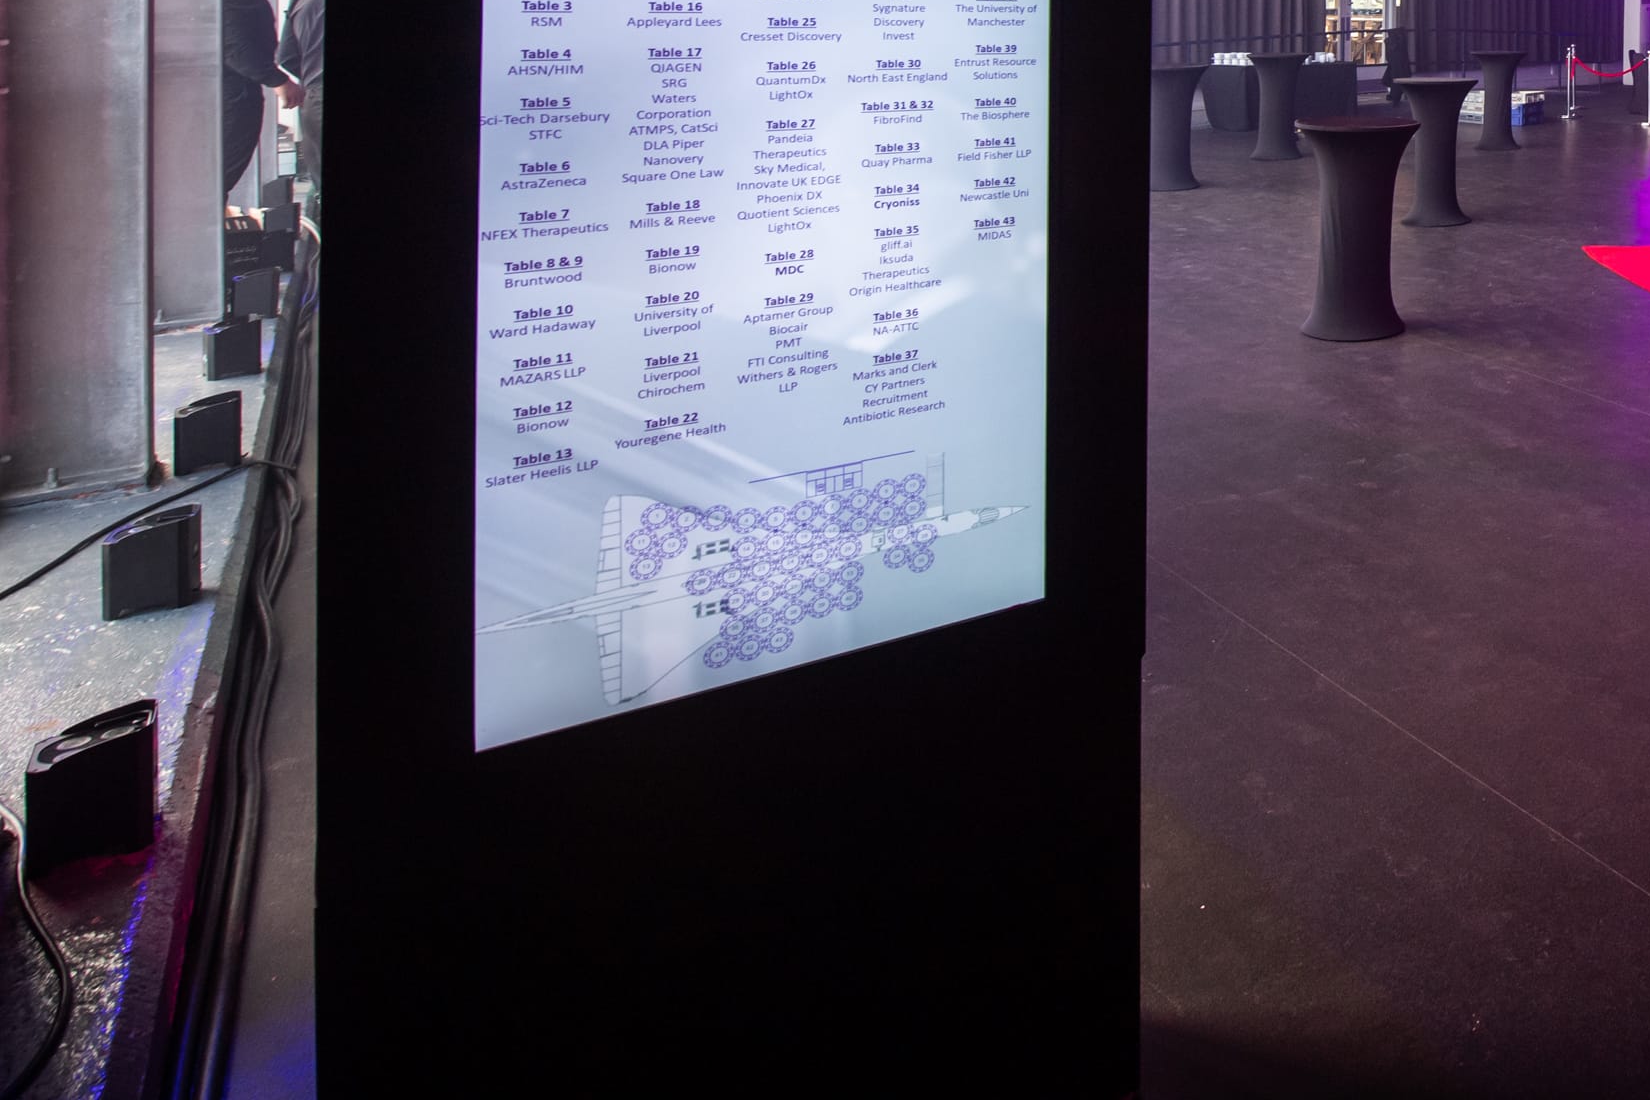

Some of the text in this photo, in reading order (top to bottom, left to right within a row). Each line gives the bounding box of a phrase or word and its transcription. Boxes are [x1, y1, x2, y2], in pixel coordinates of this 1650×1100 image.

[872, 3, 926, 15] Sygnature
[530, 16, 563, 27] RSM
[626, 16, 722, 29] Appleyard Lees
[873, 17, 925, 29] Discovery
[967, 17, 1026, 27] Manchester
[740, 31, 842, 43] Cresset Discovery
[882, 31, 915, 41] Invest
[650, 62, 702, 74] QIAGEN
[954, 57, 1037, 68] Entrust Resource
[507, 64, 584, 77] AHSN/HIM
[847, 71, 948, 84] North East England
[972, 70, 1019, 81] Solutions
[661, 78, 688, 89] SRG
[755, 75, 826, 86] QuantumDx
[519, 96, 571, 108] Table 5
[651, 94, 697, 104] Waters
[769, 90, 814, 102] LightOx
[974, 97, 1017, 107] Table 40
[540, 111, 610, 124] Darsebury
[636, 108, 712, 122] Corporation
[873, 113, 923, 125] FibroFind
[959, 110, 1030, 122] The Biosphere
[528, 128, 563, 141] STFC
[628, 122, 719, 136] ATMPS, CatSci
[643, 139, 705, 151] DLA Piper
[643, 155, 705, 167] Nanovery
[752, 148, 827, 161] Therapeutics
[957, 148, 1032, 162] Field Fisher LLP
[861, 156, 933, 169] Quay Pharma
[621, 168, 725, 185] Square One Law
[753, 164, 775, 176] Sky
[500, 177, 587, 191] AstraZeneca
[736, 174, 841, 191] Innovate UK EDGE
[874, 183, 920, 195] Table 34
[959, 188, 1030, 202] Newcastle Uni
[873, 197, 921, 211] Cryoniss
[518, 208, 570, 221] Table 7
[736, 205, 841, 221] Quotient Sciences
[629, 215, 716, 229] Mills & Reeve
[973, 216, 1016, 228] Table 43
[482, 222, 609, 242] NFEX Therapeutics
[977, 229, 1012, 241] MIDAS
[764, 248, 815, 262] Table 28
[648, 262, 697, 275] Bionow
[775, 264, 805, 276] MDC
[861, 266, 930, 281] Therapeutics
[504, 271, 583, 289] Bruntwood
[848, 279, 942, 297] Origin Healthcare
[644, 290, 700, 305] Table 20
[513, 304, 574, 320] Table 10
[634, 302, 714, 323] University of
[743, 306, 834, 325] Aptamer Group
[488, 319, 597, 340] Ward Hadaway
[643, 320, 701, 337] Liverpool
[769, 322, 809, 336] Biocair
[775, 336, 803, 350] PMT
[747, 349, 830, 369] FTI Consulting
[872, 349, 919, 364] Table 37
[499, 366, 586, 388] MAZARS LLP
[643, 365, 701, 384] Liverpool
[736, 362, 839, 385] Withers & Rogers
[637, 382, 706, 400] Chirochem
[862, 389, 928, 409] Recruitment
[842, 400, 946, 426] Antibiotic Research
[516, 417, 570, 435] Bionow
[644, 412, 699, 429] Table 22
[614, 422, 727, 450] Youregene Health
[512, 448, 573, 467] Table 13
[485, 459, 599, 489] Slater Heelis LLP
